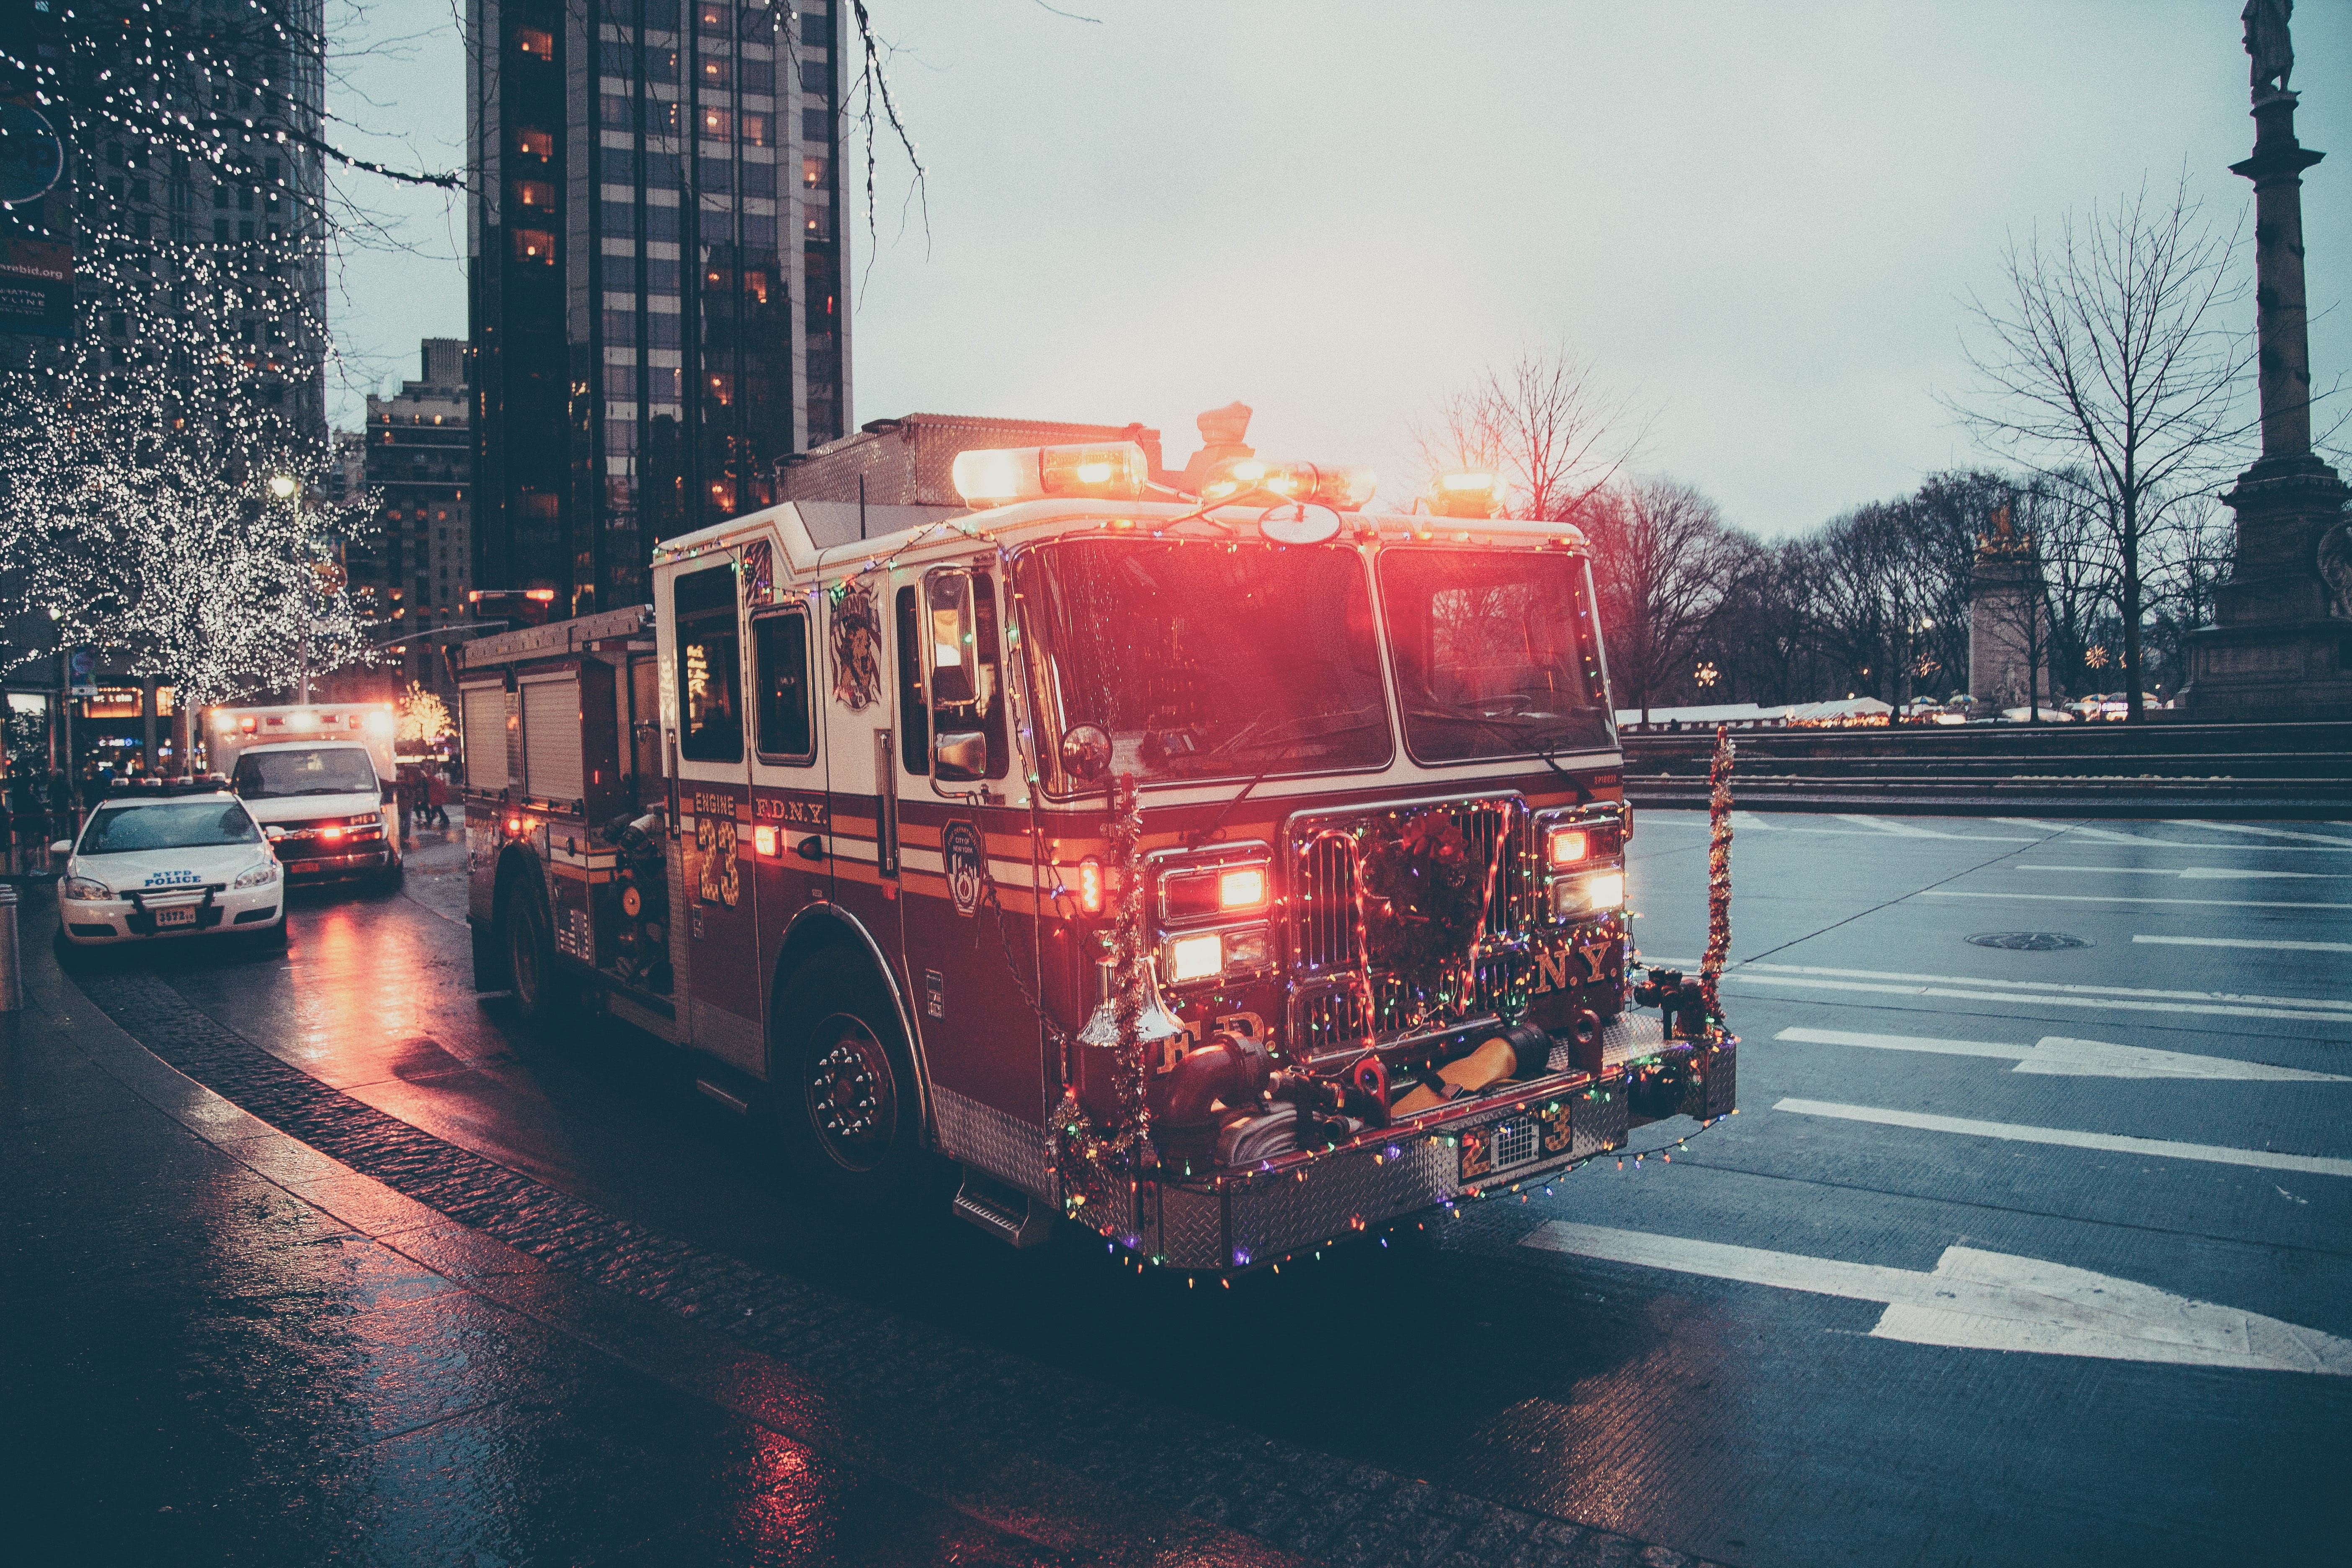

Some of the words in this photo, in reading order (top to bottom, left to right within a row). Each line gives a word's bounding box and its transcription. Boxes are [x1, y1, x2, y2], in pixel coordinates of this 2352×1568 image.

[696, 792, 735, 815] ENGINE
[756, 798, 827, 825] F.D.N.Y.
[699, 818, 739, 906] 23
[144, 876, 201, 887] POLICE
